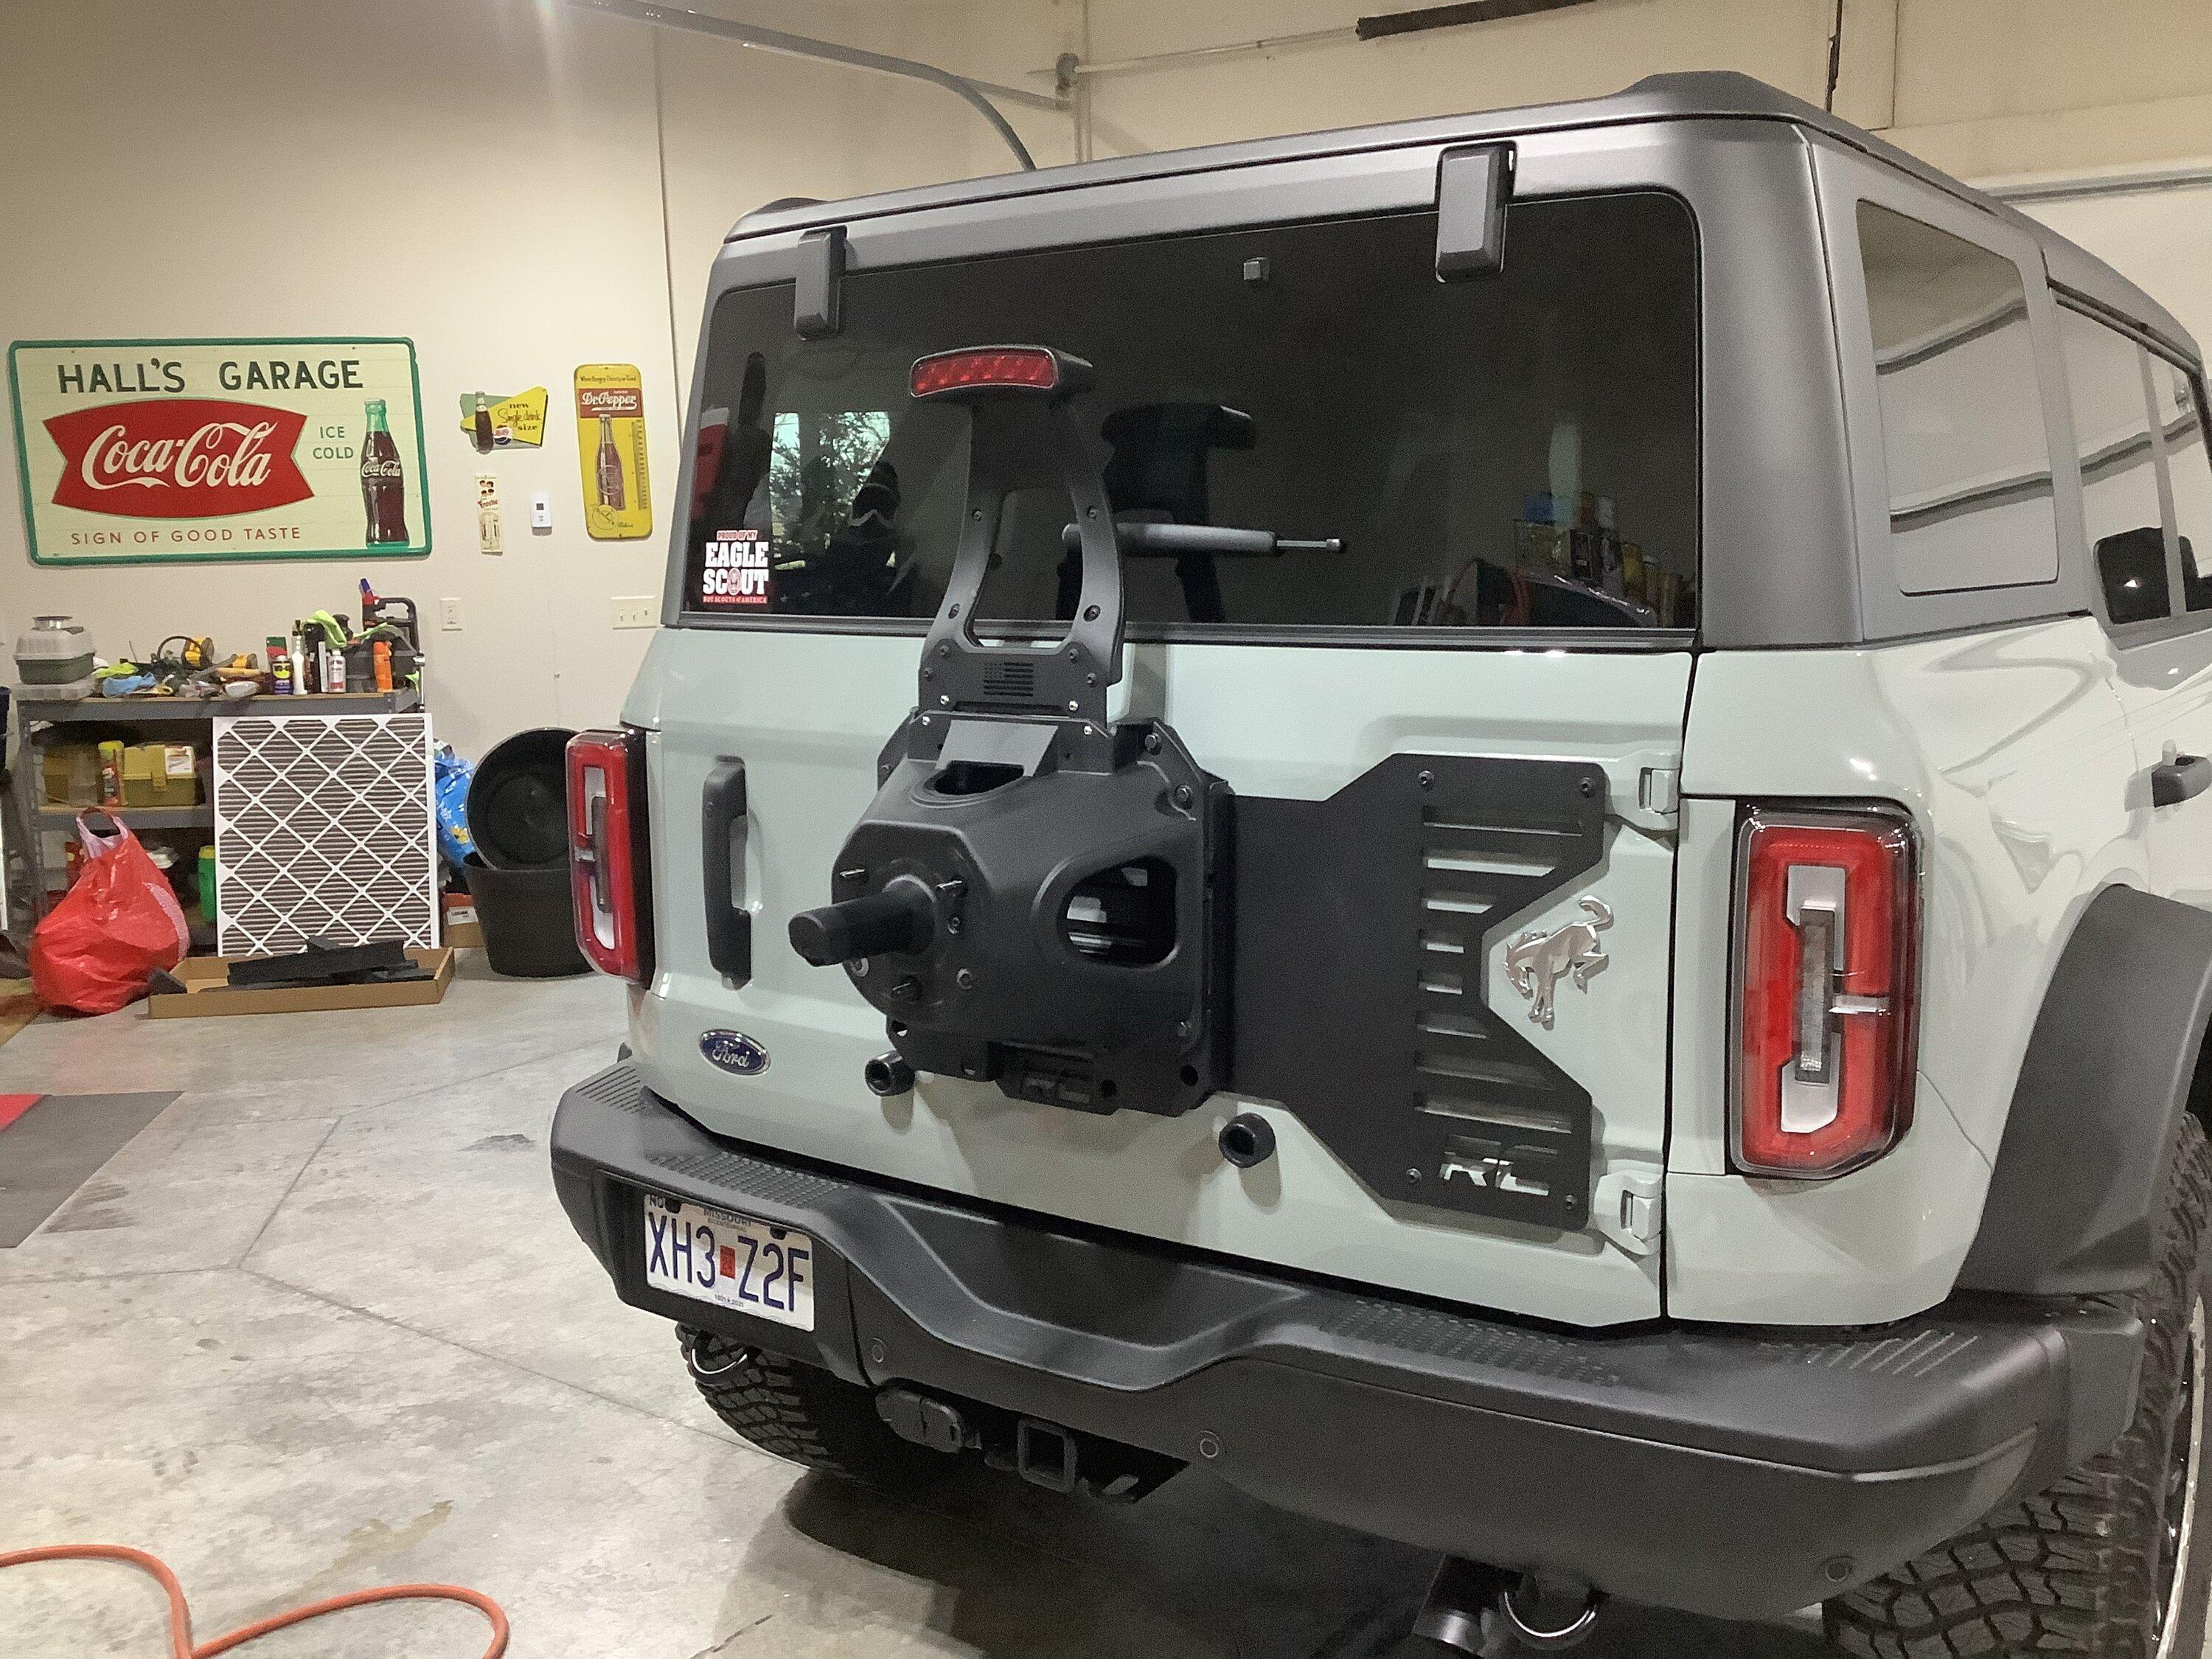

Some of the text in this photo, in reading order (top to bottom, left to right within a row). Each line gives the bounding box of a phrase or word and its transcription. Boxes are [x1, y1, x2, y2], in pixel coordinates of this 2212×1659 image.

[58, 358, 364, 394] HALL'S GARAGE
[319, 426, 345, 439] ICE
[518, 423, 538, 431] size
[82, 420, 278, 490] Coca-Cola
[313, 446, 354, 460] COLD
[72, 527, 301, 545] SIGN OF GOOD TASTE
[705, 541, 769, 568] EAGLE
[703, 568, 769, 595] SCOUT
